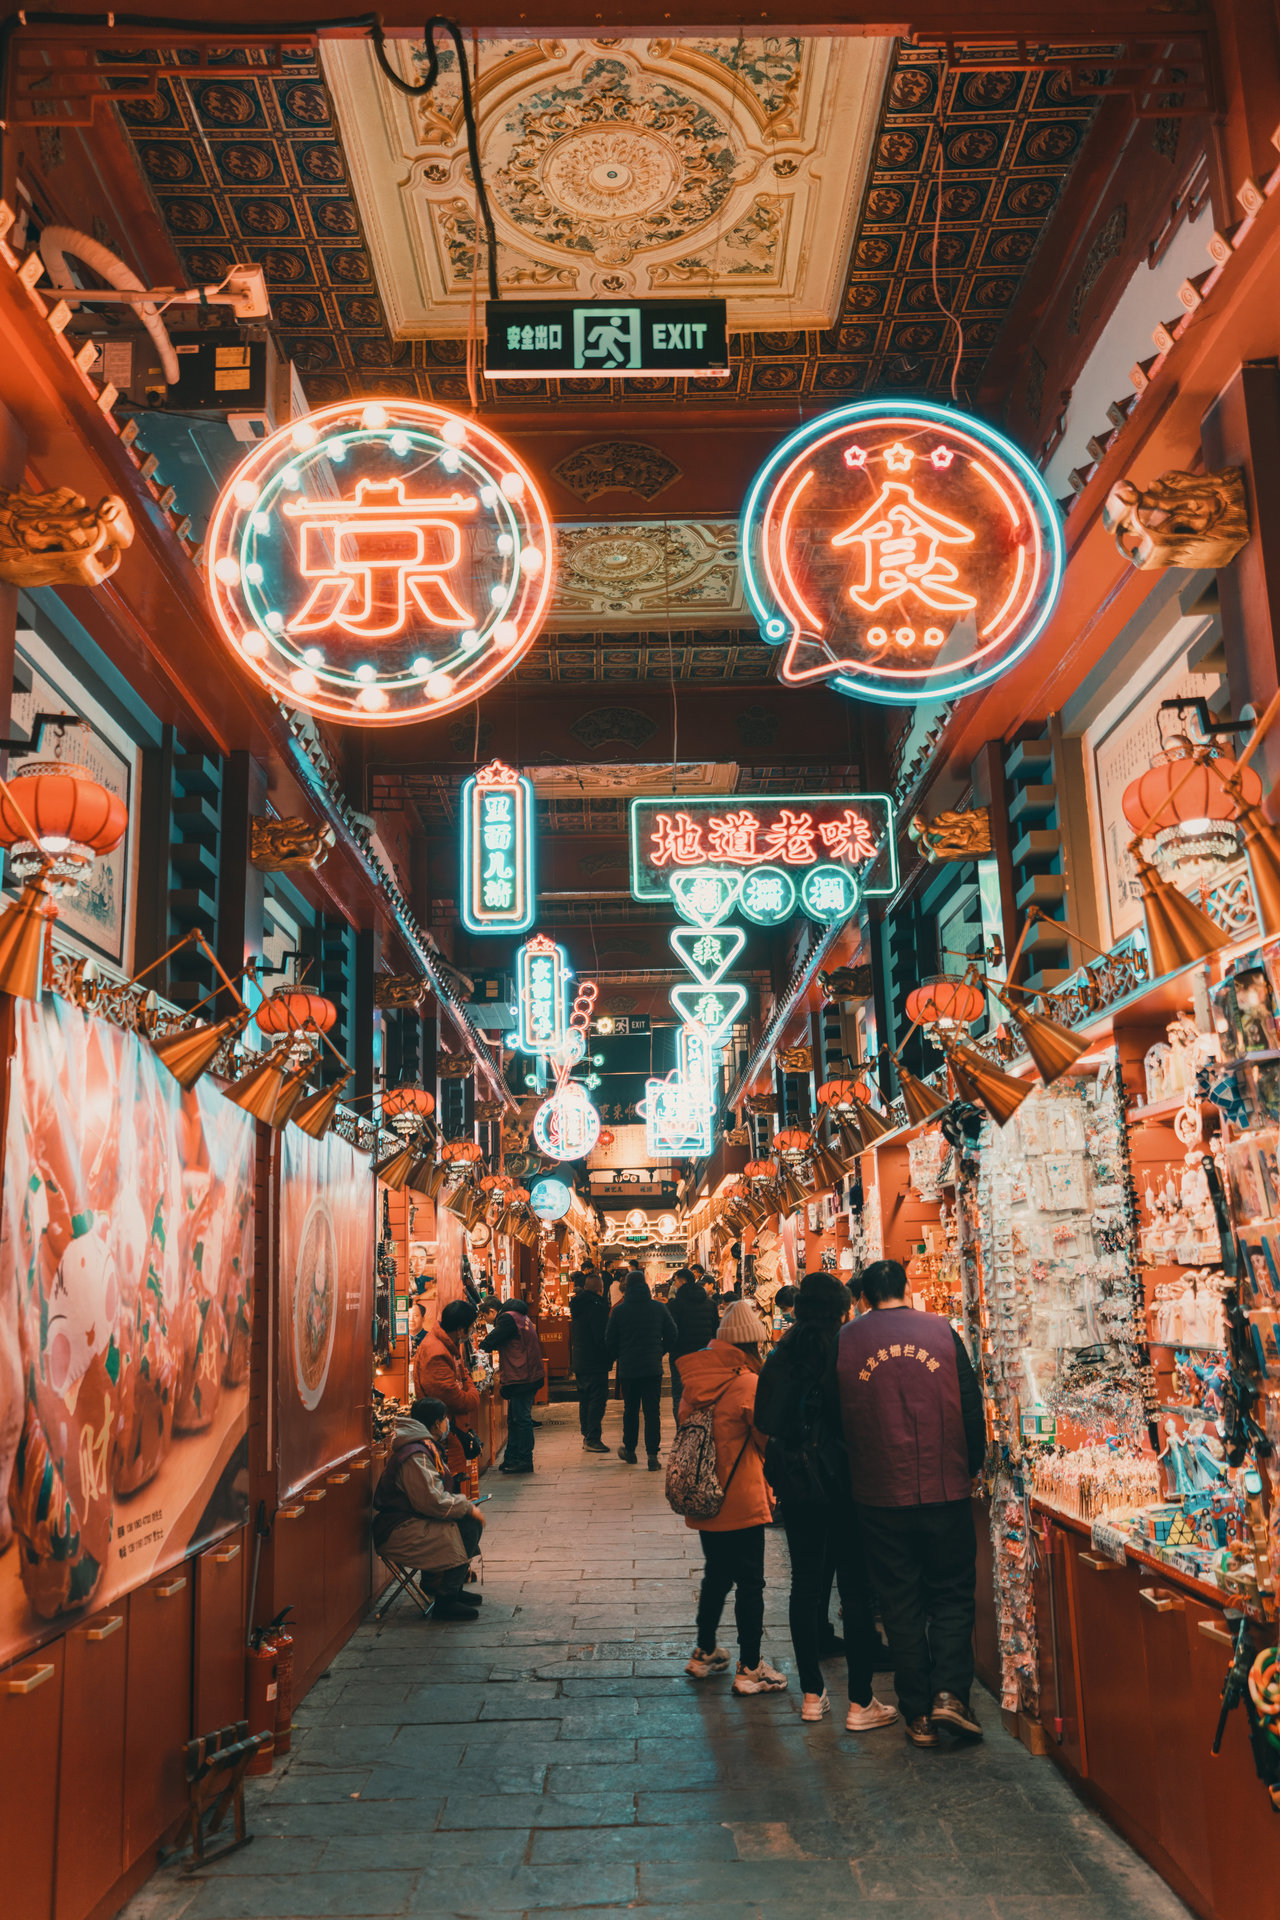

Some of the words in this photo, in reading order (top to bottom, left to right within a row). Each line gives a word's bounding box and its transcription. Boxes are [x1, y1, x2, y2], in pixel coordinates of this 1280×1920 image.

[506, 324, 563, 351] 安全出口
[652, 323, 708, 350] EXIT
[282, 477, 478, 637] 京
[831, 481, 978, 613] 食
[631, 1020, 646, 1029] EXIT
